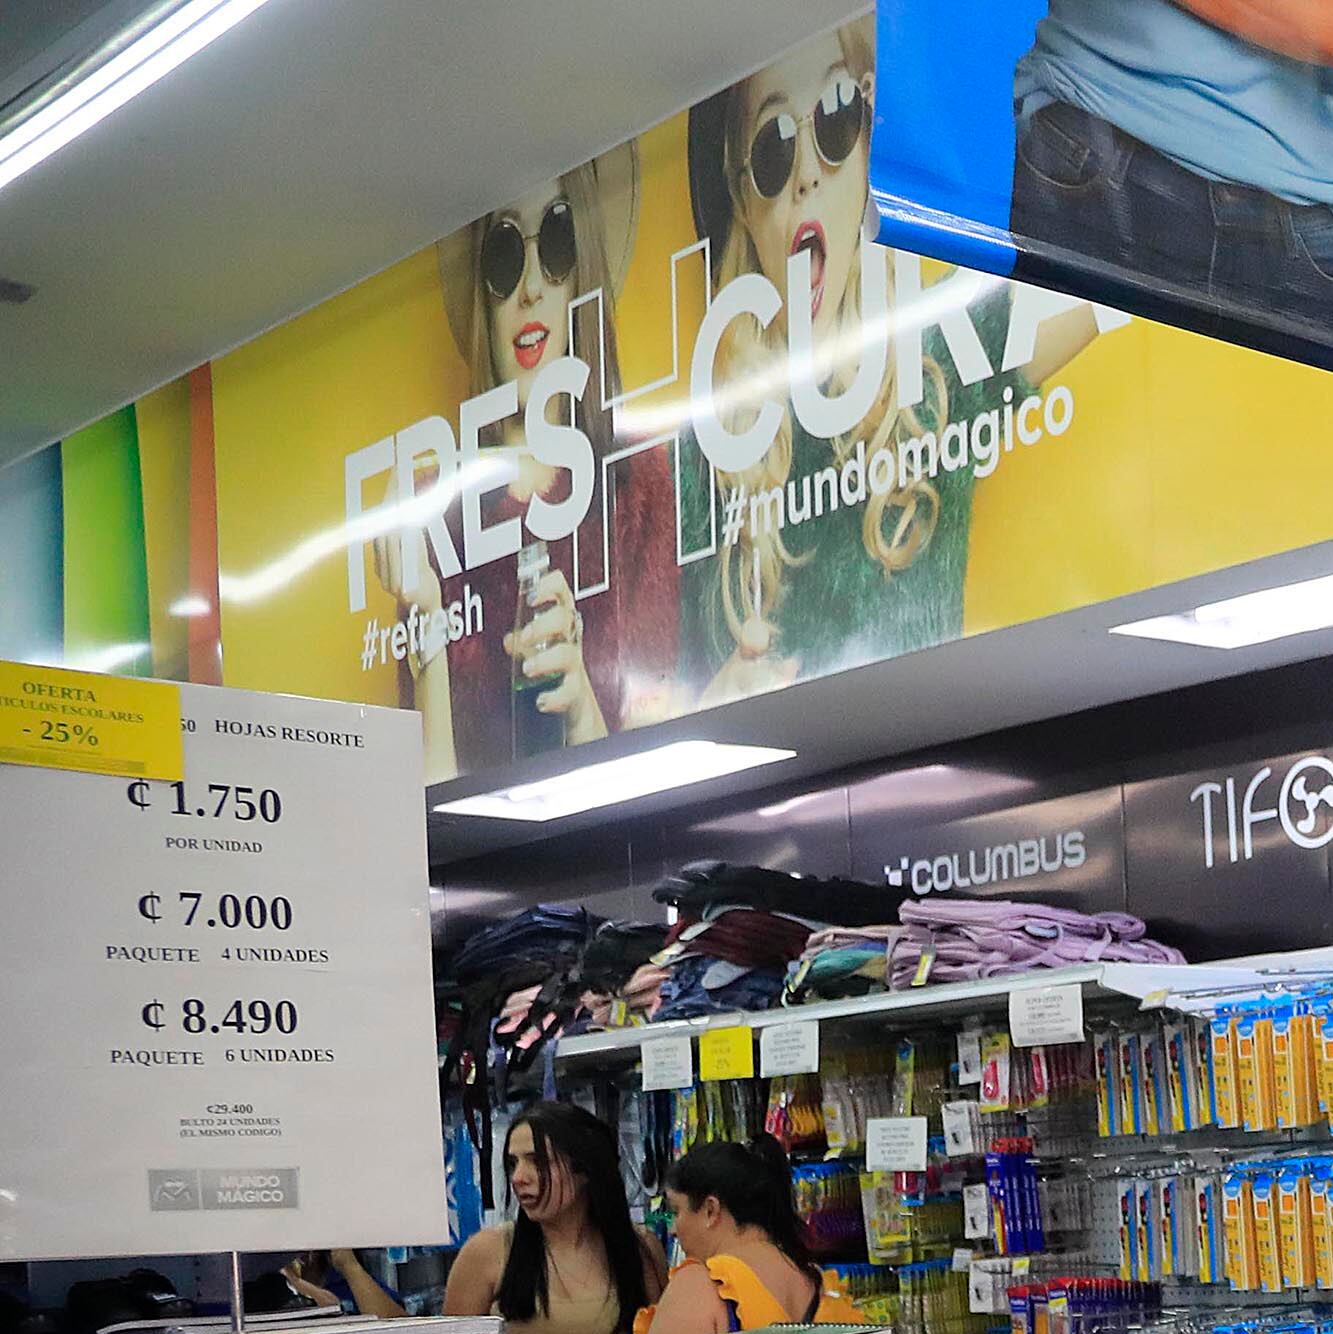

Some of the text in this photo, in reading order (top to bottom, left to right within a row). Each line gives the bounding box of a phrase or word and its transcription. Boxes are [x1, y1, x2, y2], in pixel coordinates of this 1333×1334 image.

[723, 386, 1073, 545] #mundomagico
[361, 584, 484, 671] #refresh
[22, 681, 96, 702] OFERTA
[0, 694, 144, 724] TICULOS ESCOLARES
[215, 719, 277, 740] HOJAS
[281, 727, 365, 749] RESORTE
[170, 780, 282, 823] 1.750
[166, 836, 263, 854] POR UNIDAD
[911, 832, 1086, 895] COLUMBUS
[179, 892, 293, 930] 7.000
[106, 945, 329, 963] PAQUETE 4 UNIDADES
[182, 999, 298, 1034] 8.490
[110, 1049, 334, 1066] PAQUETE 6 UNIDADES
[219, 1175, 281, 1189] MUNDO
